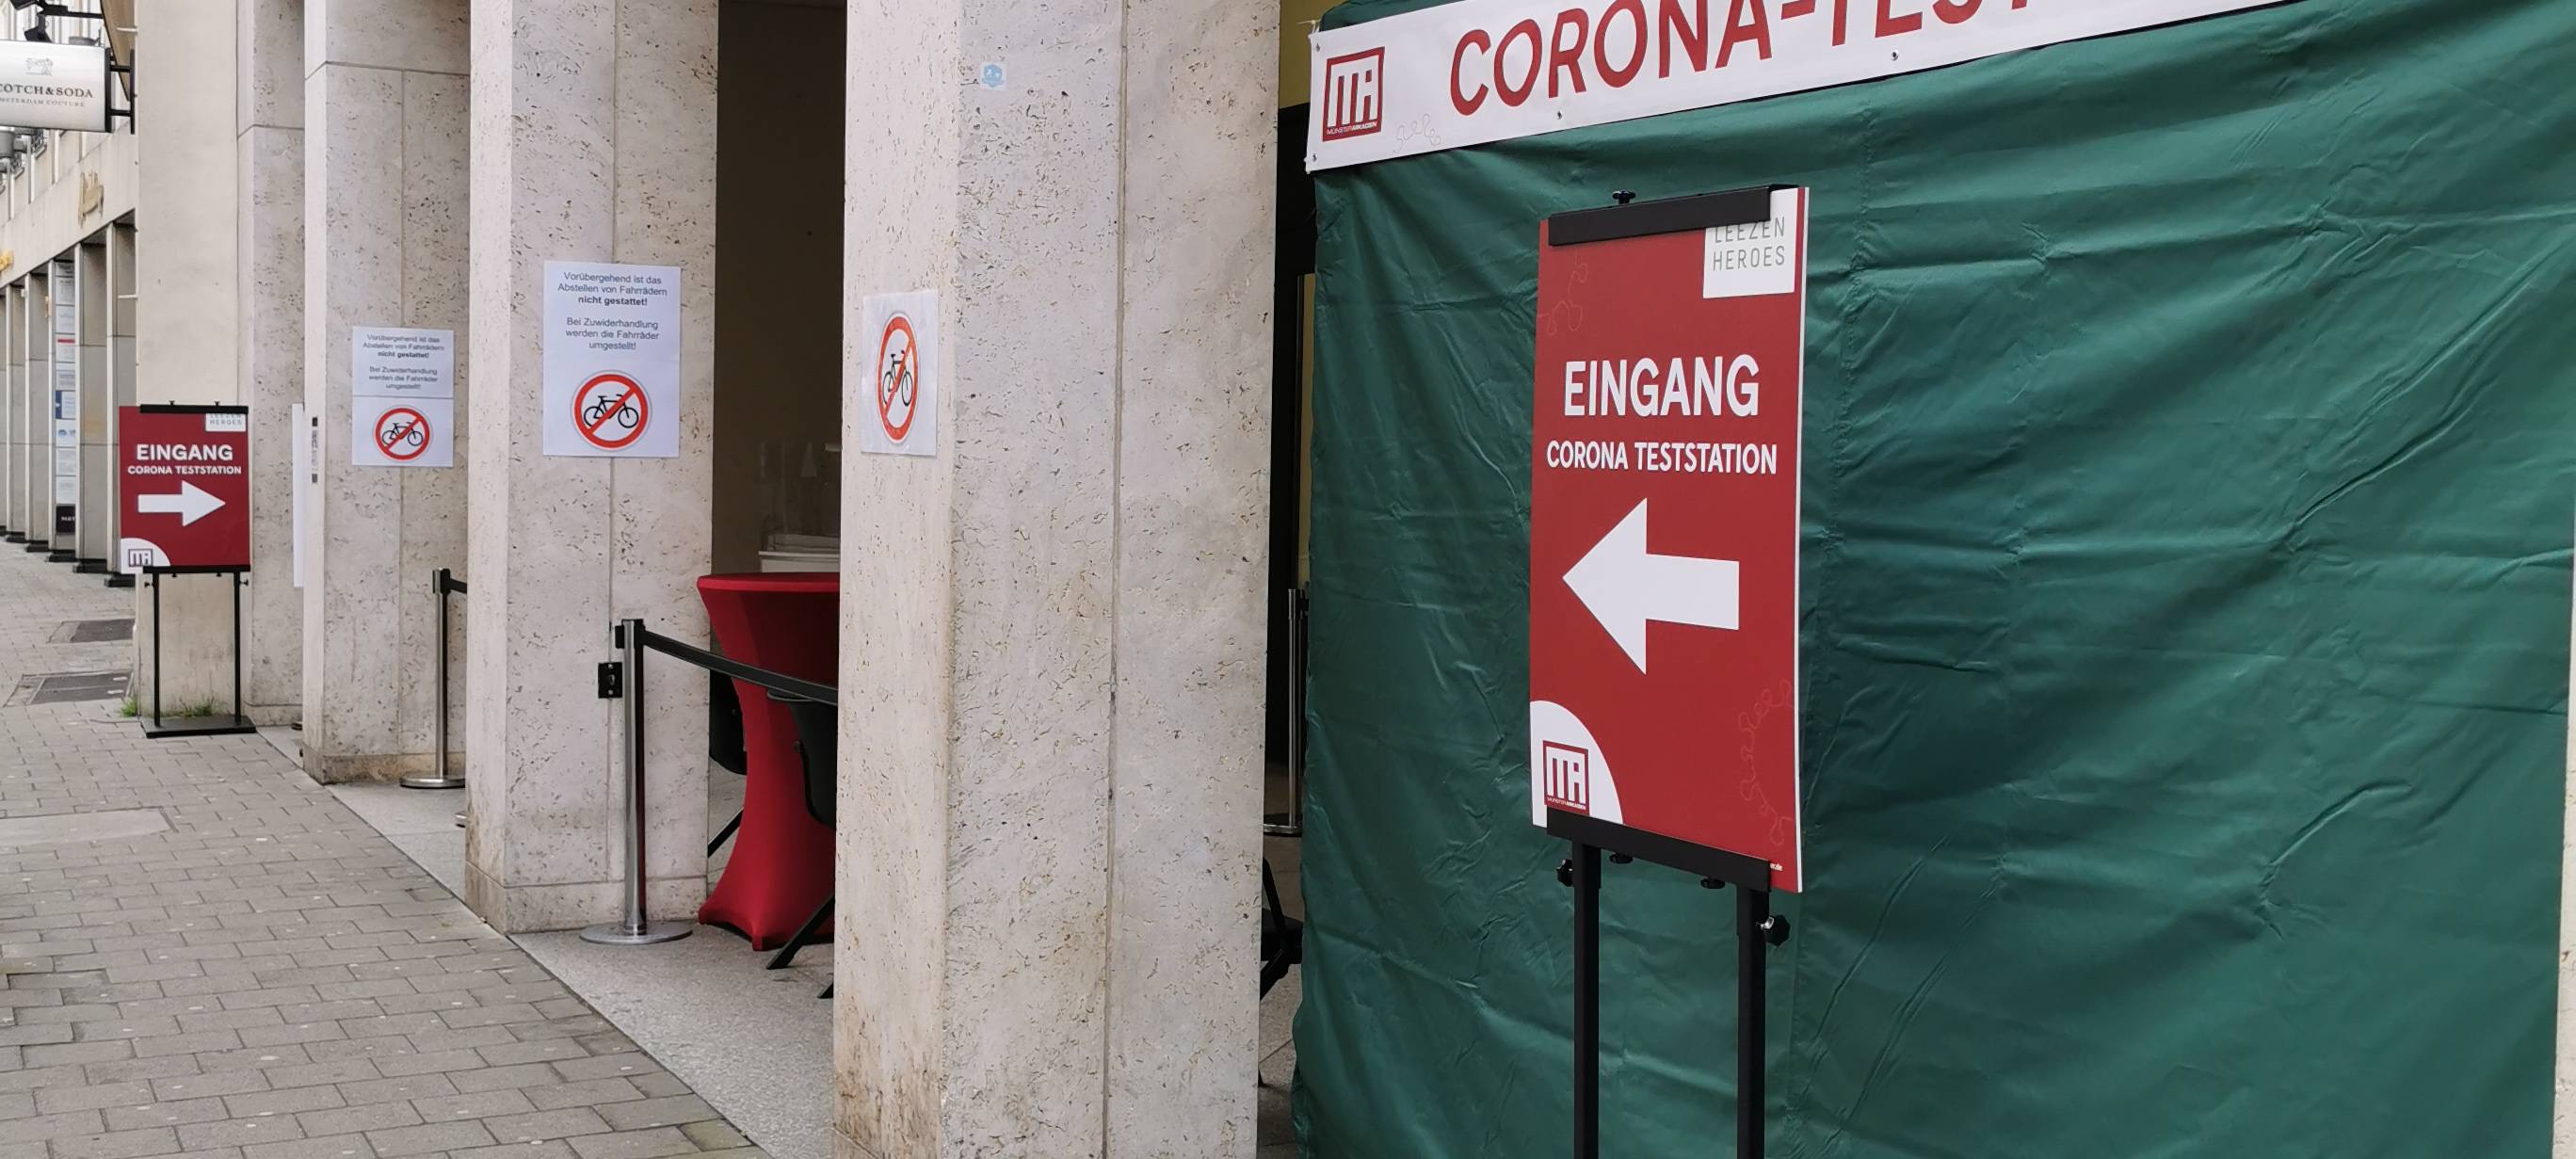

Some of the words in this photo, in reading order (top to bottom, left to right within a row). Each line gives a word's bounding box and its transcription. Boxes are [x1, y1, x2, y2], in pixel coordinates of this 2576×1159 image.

[1450, 0, 2027, 116] CORONA-
[1713, 245, 1785, 271] HEROES
[564, 271, 631, 283] Vorübergehend
[634, 275, 644, 283] ist
[646, 276, 662, 284] das
[557, 282, 598, 293] Abstellen
[620, 285, 668, 296] Fahrrädern
[578, 296, 602, 304] nicht
[604, 298, 648, 306] gestattet!
[566, 317, 581, 326] Bei
[584, 317, 658, 330] Zuwiderhandlung
[565, 330, 598, 338] werden
[601, 330, 614, 339] die
[617, 330, 660, 340] Fahrräder
[588, 342, 636, 351] umgestellt!
[1564, 353, 1760, 417] EINGANG
[136, 443, 233, 461] EINGANG
[1546, 440, 1629, 470] CORONA
[1634, 443, 1778, 475] TESTSTATION
[127, 465, 173, 475] CORONA
[174, 465, 242, 475] TESTSTATION
